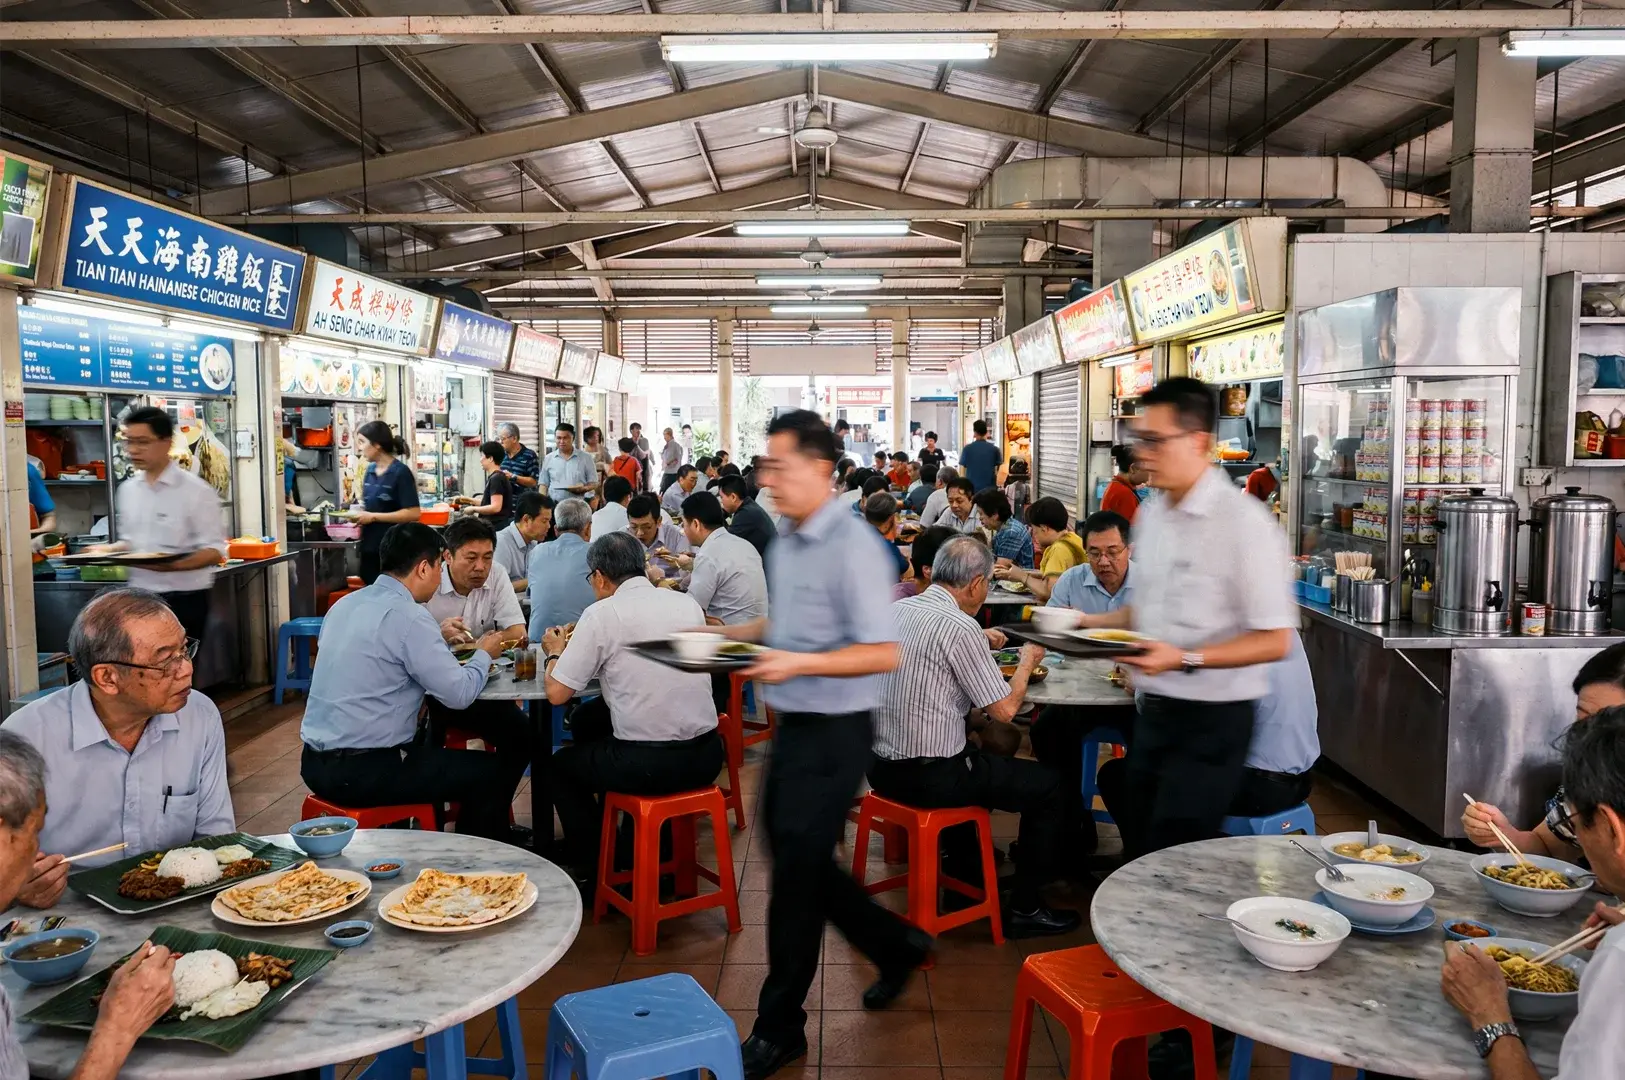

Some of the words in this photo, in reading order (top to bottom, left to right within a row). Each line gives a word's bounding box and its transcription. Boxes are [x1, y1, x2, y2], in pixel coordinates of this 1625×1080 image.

[79, 206, 265, 293] 天天海南雞飯
[76, 258, 106, 281] TIAN
[109, 266, 137, 288] TIAN
[138, 273, 199, 300] HAINANESE
[200, 287, 241, 310] CHICKEN
[241, 296, 262, 313] RICE
[313, 311, 328, 330] AH
[329, 314, 353, 335] SENG
[354, 320, 377, 340] CHAR
[376, 325, 397, 344] KWAY
[399, 330, 417, 347] TEOW
